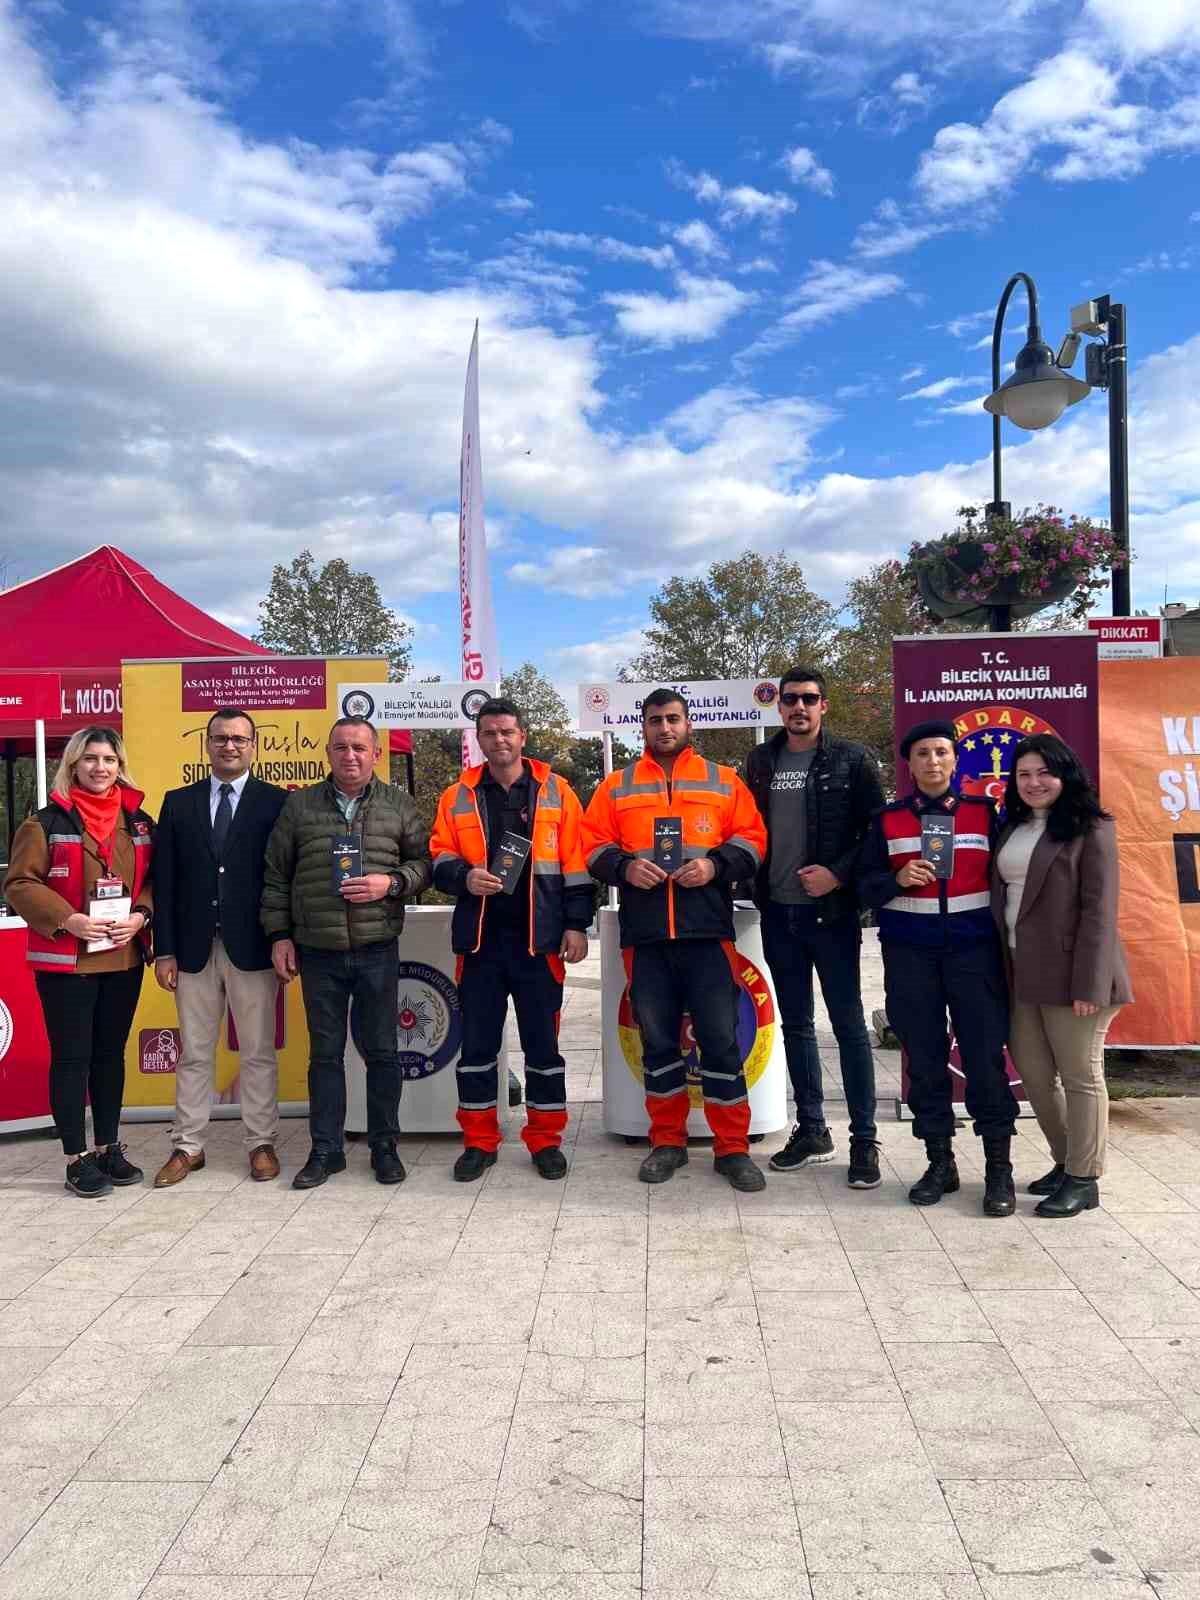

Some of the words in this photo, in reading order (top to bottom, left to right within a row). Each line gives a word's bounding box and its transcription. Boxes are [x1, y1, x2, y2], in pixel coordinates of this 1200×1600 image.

[1100, 627, 1148, 639] DİKKAT!
[232, 665, 276, 676] BİLECİK
[941, 669, 992, 684] BİLECİK
[995, 666, 1051, 682] VALİLİĞİ
[183, 678, 222, 689] ASAYİŞ
[224, 678, 252, 689] ŞUBE
[254, 675, 324, 687] MÜDÜRLÜĞÜ
[76, 683, 123, 714] MÜDÜ
[904, 688, 917, 703] İL
[919, 689, 994, 703] JANDARMA
[997, 684, 1088, 701] KOMUTANLIĞI
[0, 696, 23, 705] EME
[384, 700, 416, 709] BİLECİK
[419, 699, 452, 709] VALİLİĞİ
[686, 696, 729, 708] ALİLİĞİ
[384, 711, 415, 721] Emniyet
[417, 710, 459, 720] Müdürlüğü
[616, 712, 644, 724] JAND
[774, 771, 809, 781] NATION
[770, 780, 807, 790] GEOGRA
